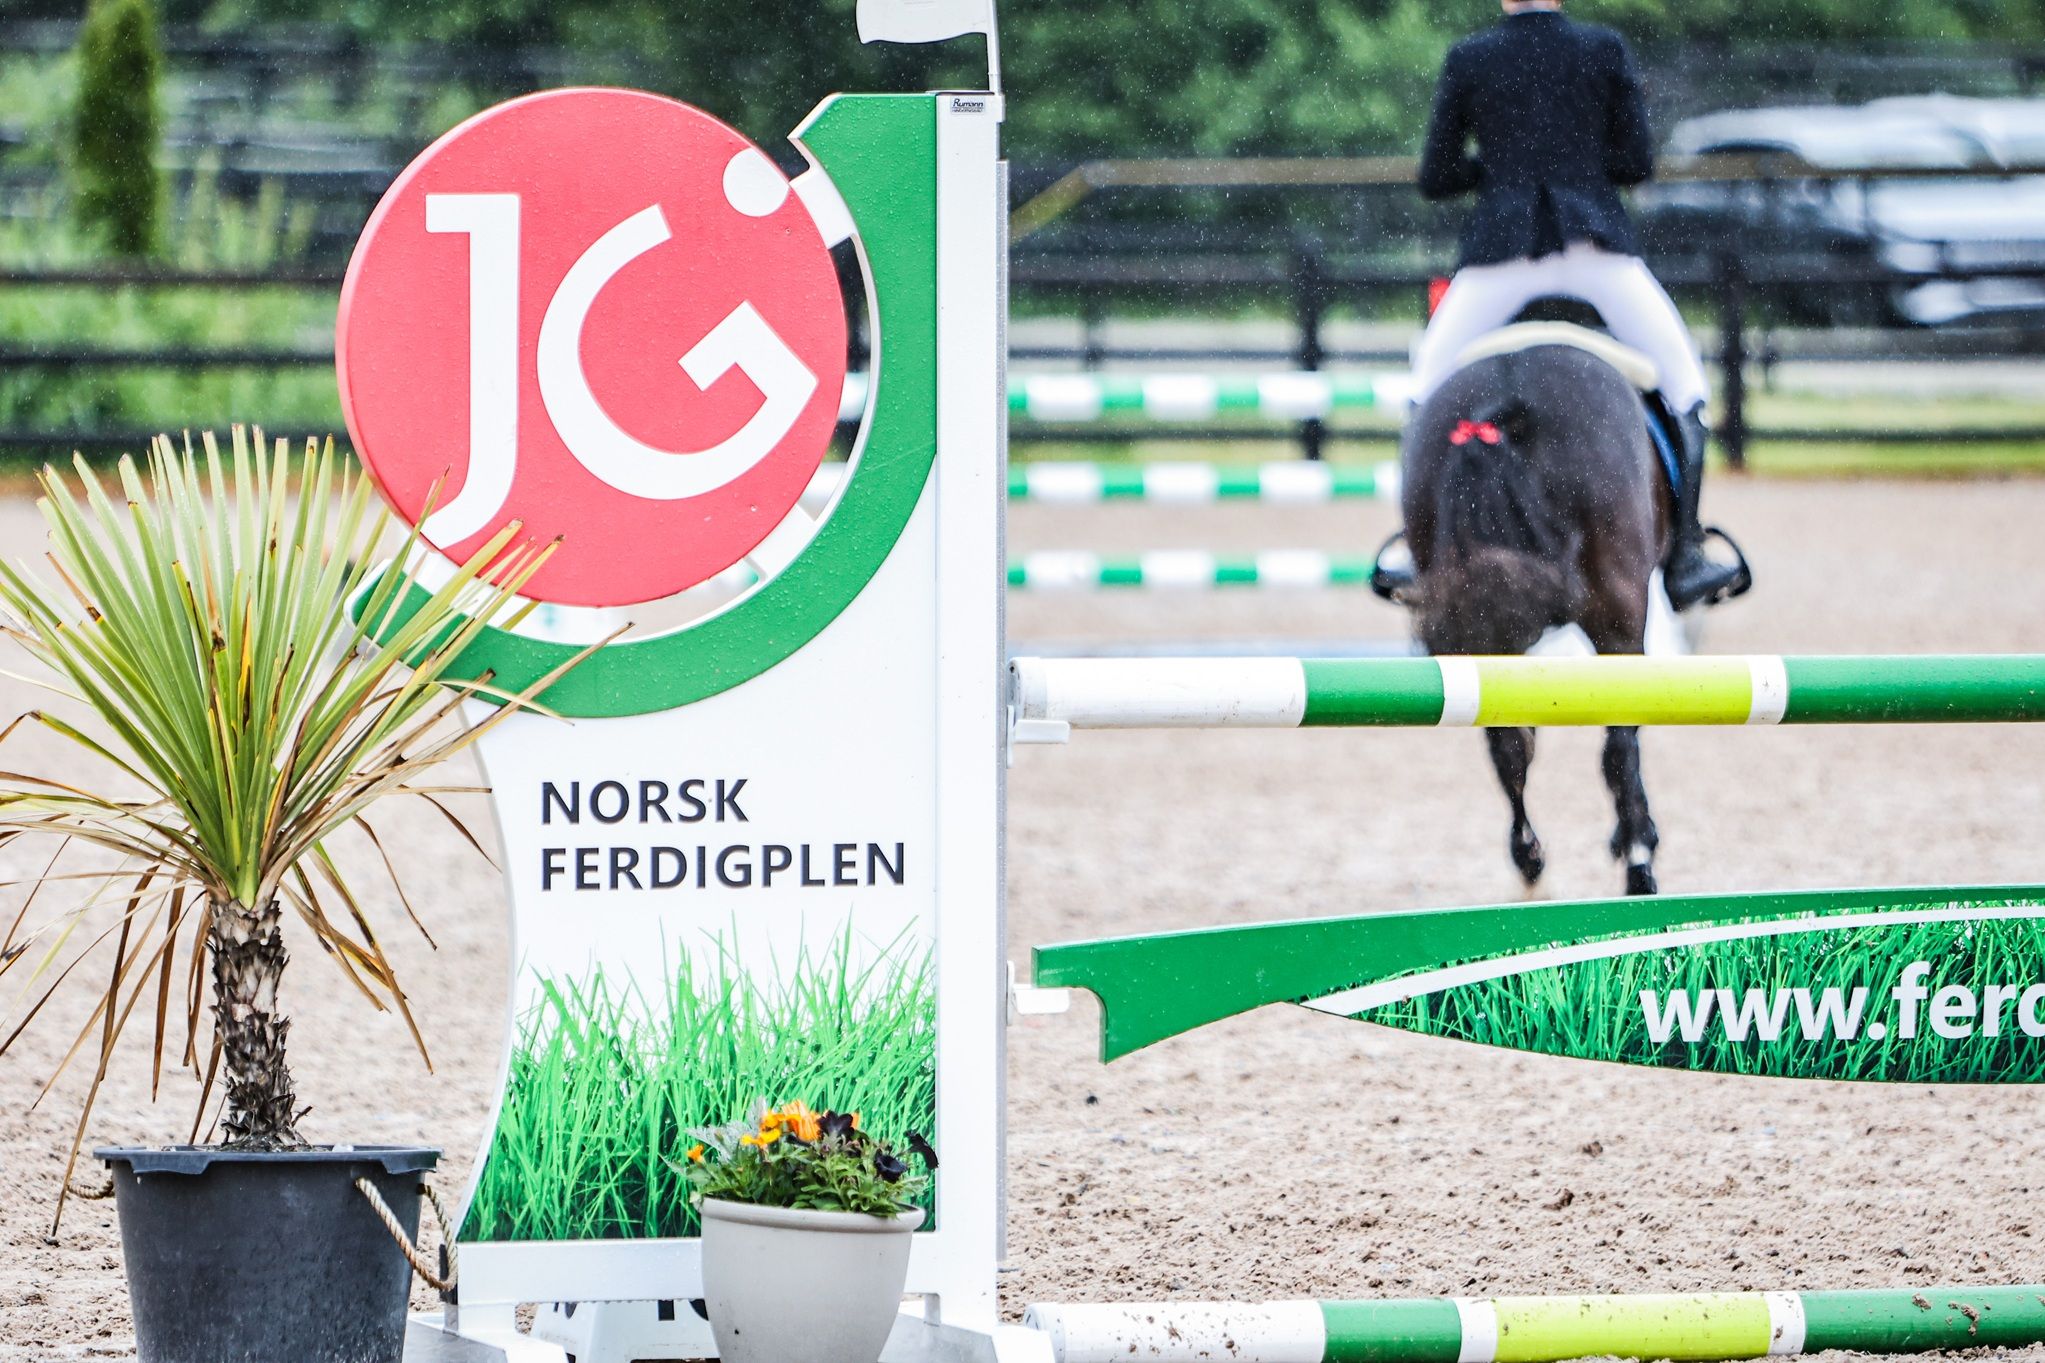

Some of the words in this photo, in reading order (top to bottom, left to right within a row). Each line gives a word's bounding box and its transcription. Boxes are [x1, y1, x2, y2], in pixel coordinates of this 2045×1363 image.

[953, 98, 984, 107] Rumann
[541, 778, 750, 825] NORSK
[541, 842, 905, 891] FERDIGPLEN
